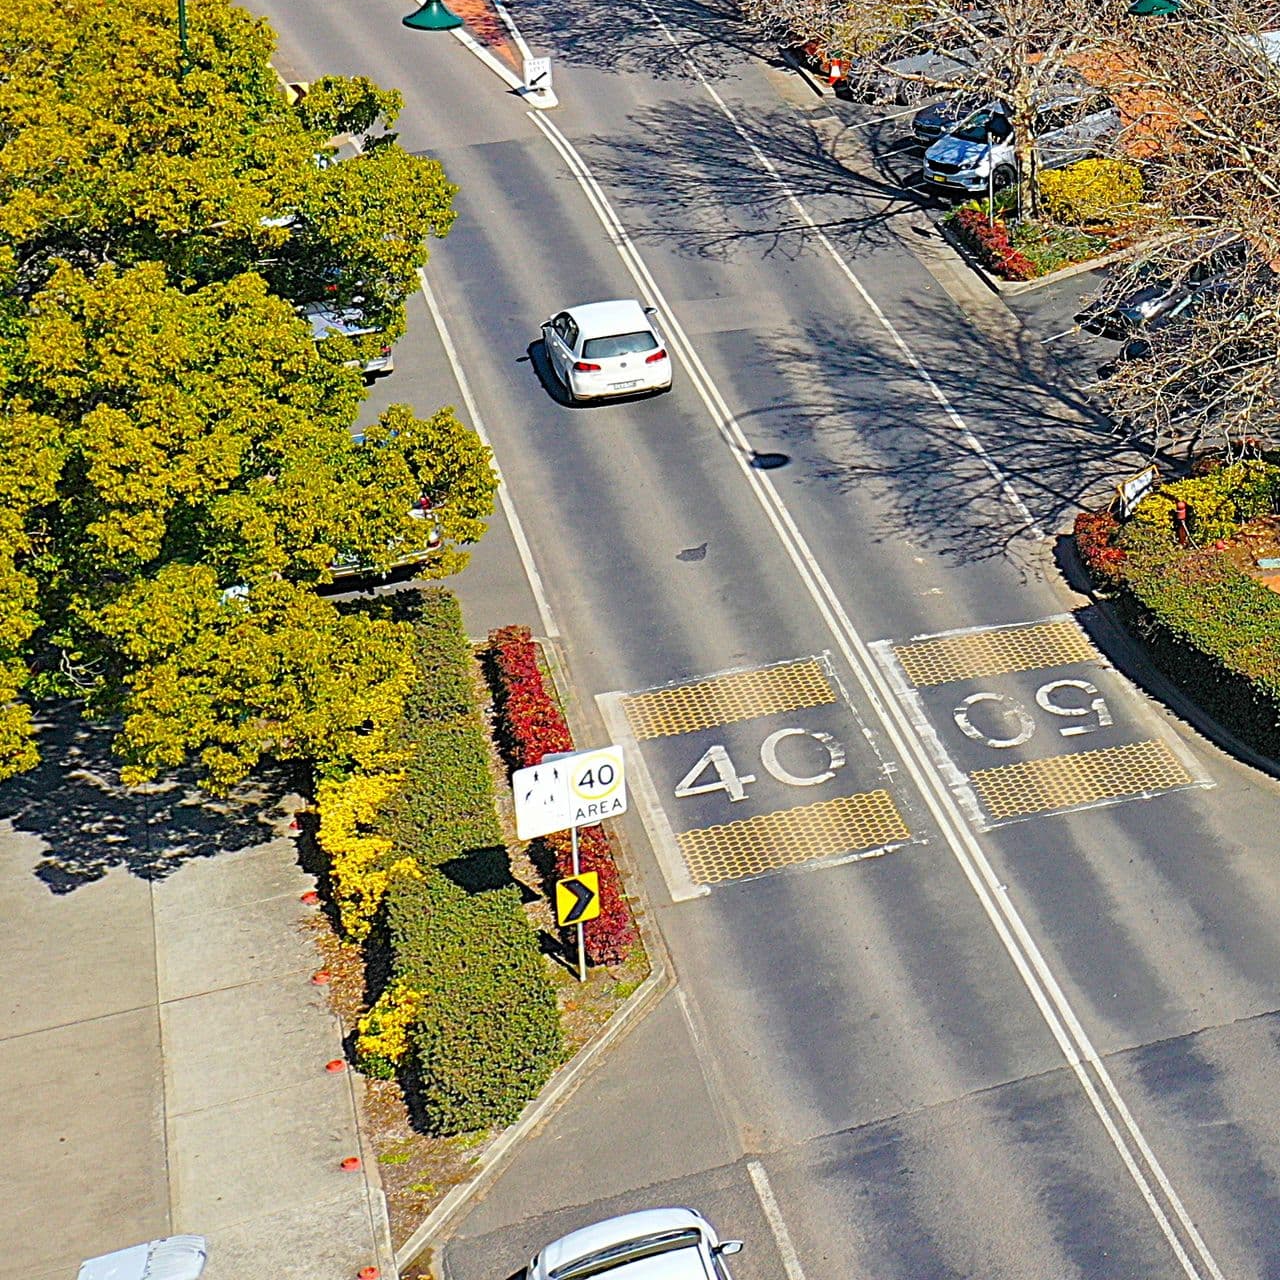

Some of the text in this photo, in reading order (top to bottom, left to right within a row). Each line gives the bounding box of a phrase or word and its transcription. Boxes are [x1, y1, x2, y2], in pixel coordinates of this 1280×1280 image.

[578, 764, 614, 789] 40
[674, 726, 847, 802] 40
[575, 797, 623, 821] AREA
